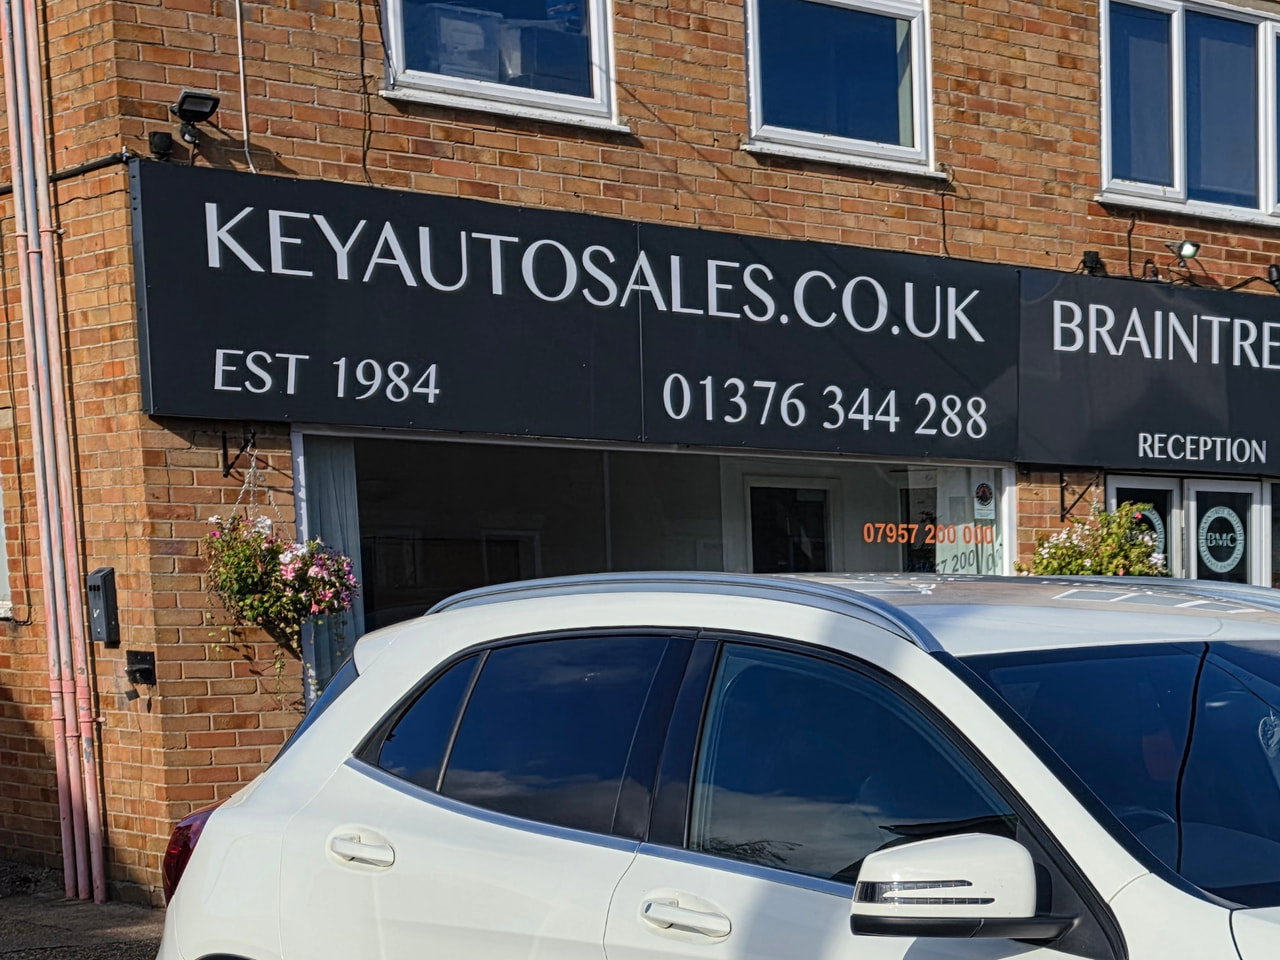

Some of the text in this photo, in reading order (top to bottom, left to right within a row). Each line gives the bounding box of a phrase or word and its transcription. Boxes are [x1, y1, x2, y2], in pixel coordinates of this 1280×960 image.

[204, 201, 985, 344] KEYAUTOSALES.CO.UK
[214, 347, 441, 405] EST 1984
[662, 372, 988, 440] 01376 344 288
[1138, 431, 1268, 465] RECEPTION
[863, 522, 994, 545] 07957 200 000
[1206, 532, 1237, 548] BMC
